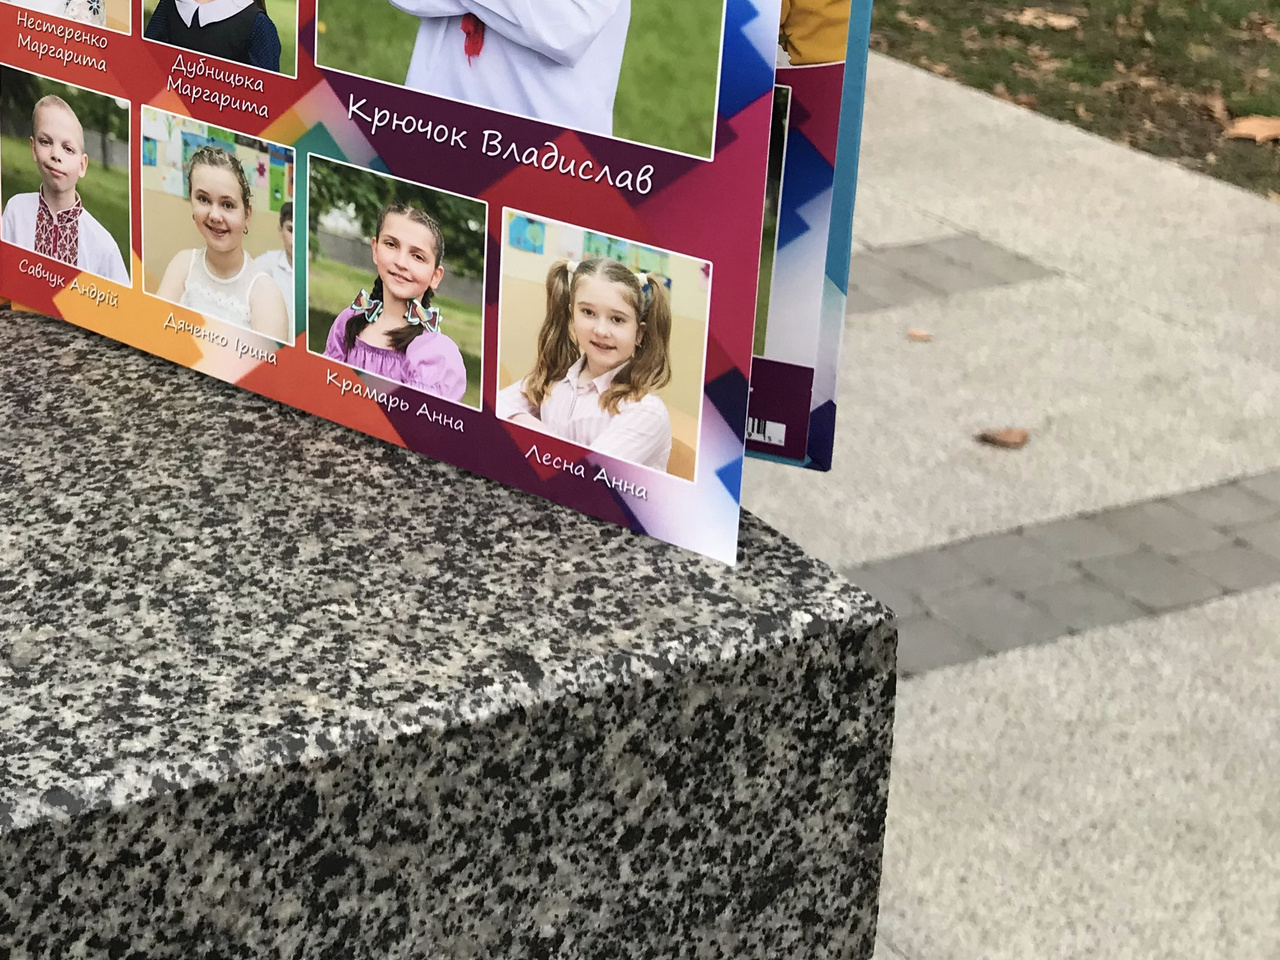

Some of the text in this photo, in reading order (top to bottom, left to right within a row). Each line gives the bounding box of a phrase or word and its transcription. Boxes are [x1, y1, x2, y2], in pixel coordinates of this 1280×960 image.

[16, 11, 108, 49] Нестеренко
[17, 32, 107, 72] Маргарита
[171, 54, 264, 92] Дубницька
[166, 76, 269, 118] Маргарита
[347, 94, 655, 194] Крючок Владислав
[18, 259, 119, 308] Савчук Андрій
[163, 312, 277, 365] Дяченко Ірина
[416, 402, 464, 432] Анна
[525, 445, 648, 500] Лесна Анна
